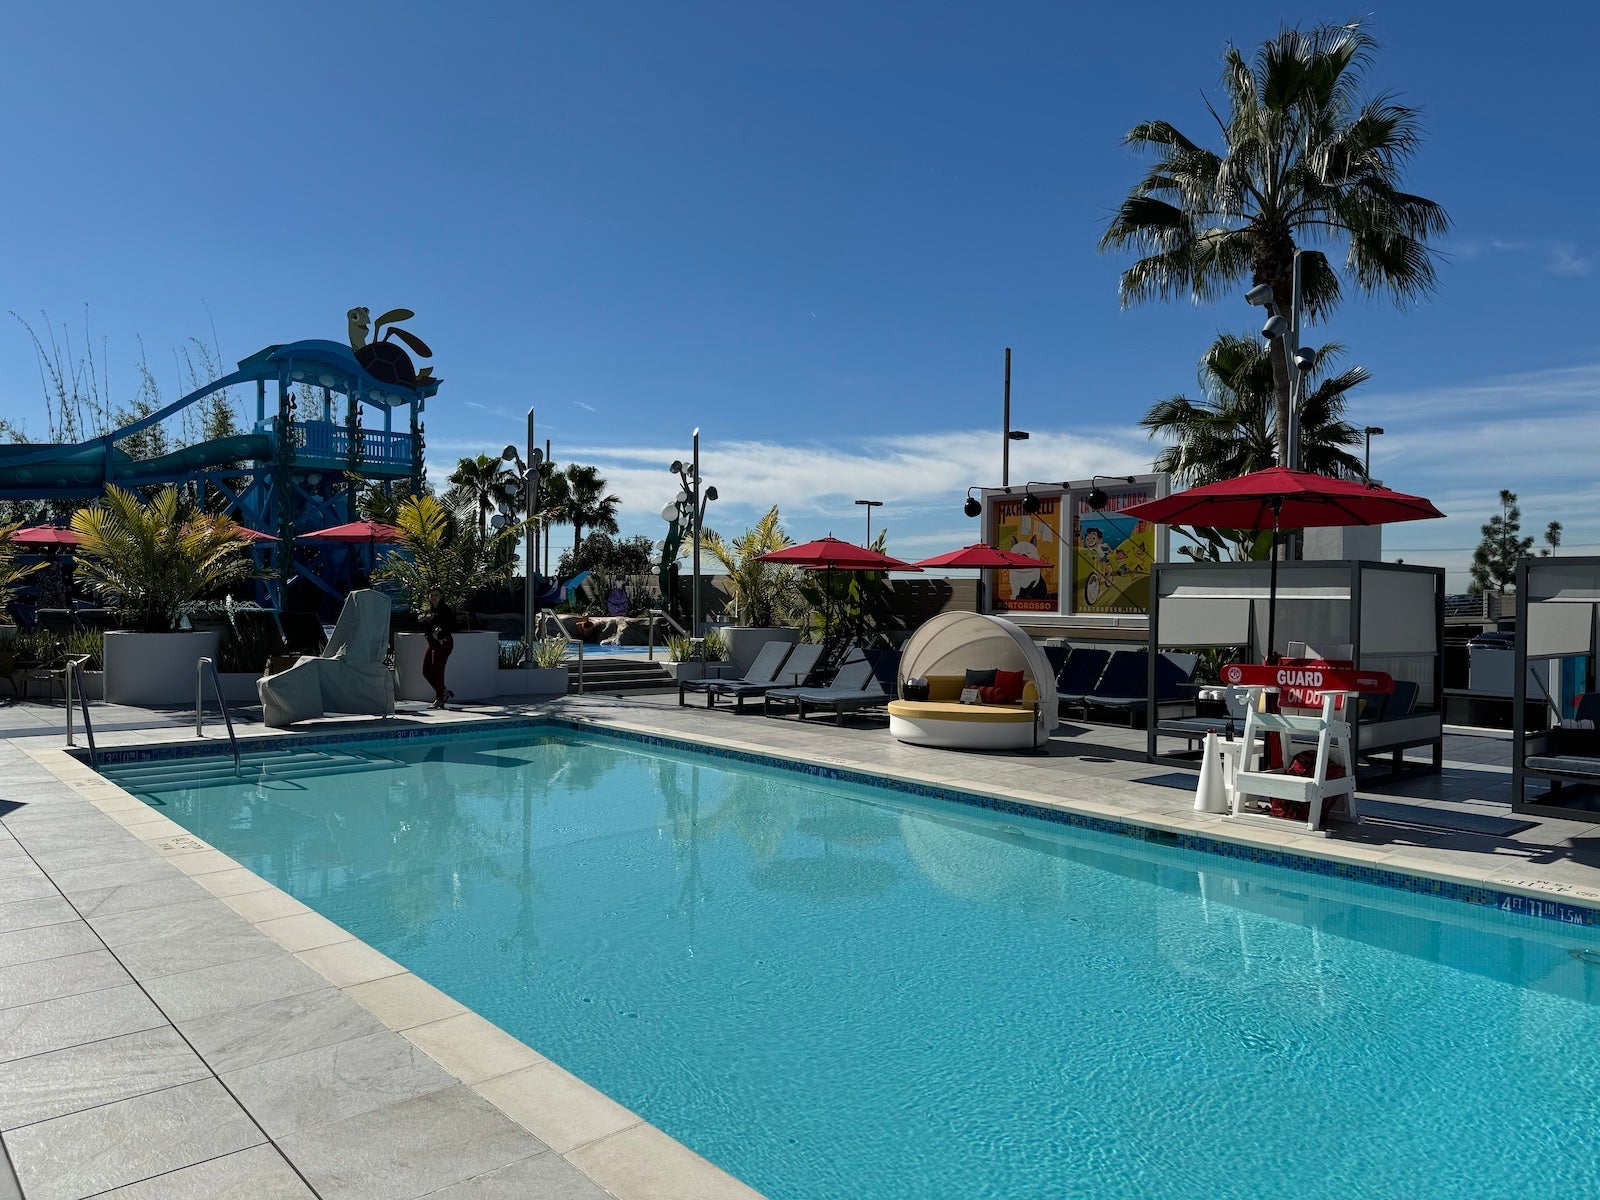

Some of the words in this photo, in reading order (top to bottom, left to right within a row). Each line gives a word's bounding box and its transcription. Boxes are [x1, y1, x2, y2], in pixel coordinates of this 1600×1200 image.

[997, 601, 1051, 610] PORTOROSSO
[1276, 669, 1324, 687] GUARD
[1287, 688, 1304, 704] ON
[1501, 896, 1512, 911] 4
[1513, 897, 1523, 909] FT
[1529, 900, 1542, 917] 11
[1544, 903, 1555, 915] IN
